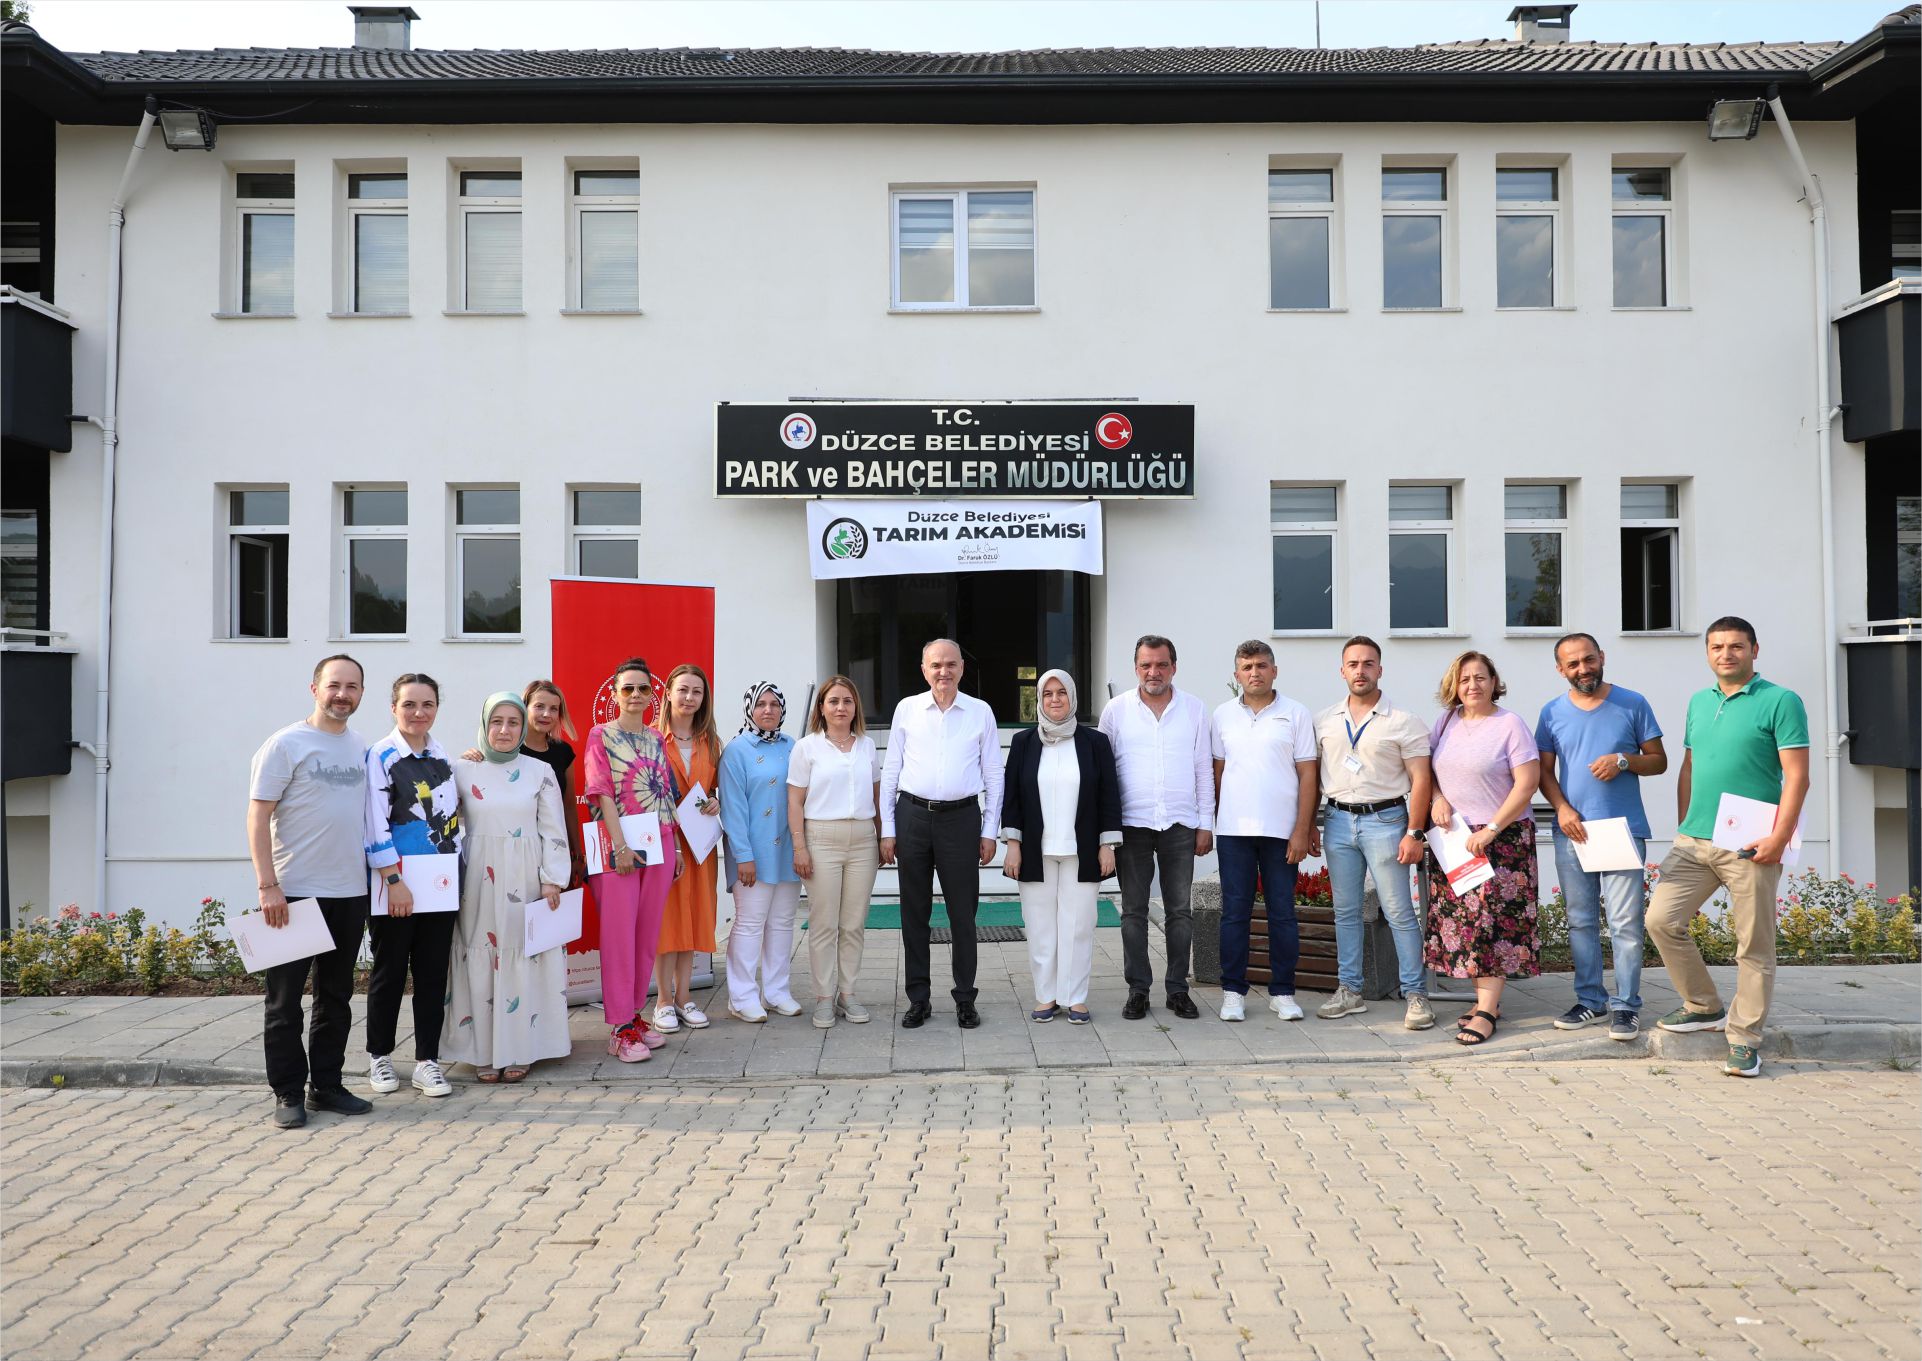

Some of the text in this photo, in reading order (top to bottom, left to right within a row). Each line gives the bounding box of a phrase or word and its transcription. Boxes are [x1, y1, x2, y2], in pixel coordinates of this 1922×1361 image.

[931, 408, 980, 425] T.C.
[821, 430, 1090, 451] DÜZCE BELEDİYESİ
[725, 453, 1187, 496] PARK ve BAHÇELER MÜDÜRLÜĞÜ
[907, 510, 1051, 524] Düzce Belediyesi
[872, 523, 1086, 543] TARIM AKADEMİSİ
